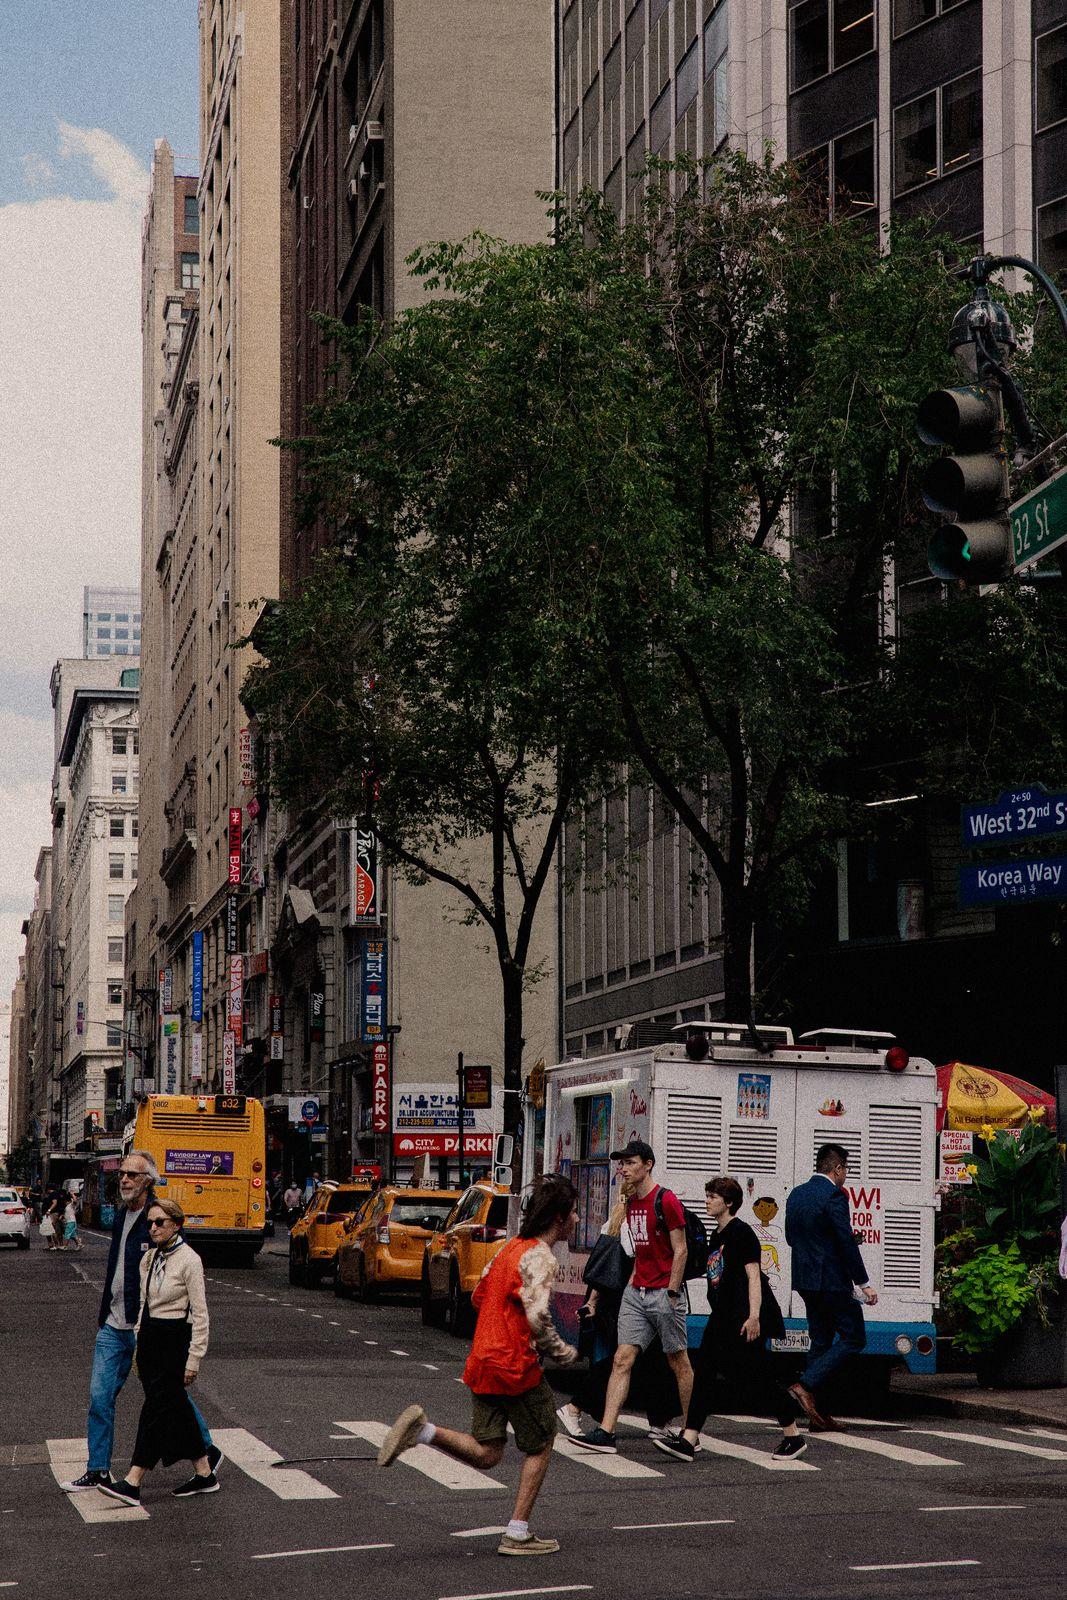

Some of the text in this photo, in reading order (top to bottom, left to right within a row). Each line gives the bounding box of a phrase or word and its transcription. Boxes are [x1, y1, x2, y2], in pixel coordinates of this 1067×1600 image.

[1014, 498, 1050, 556] 32 St
[970, 802, 1067, 837] West 32nd S
[230, 825, 240, 854] NAIL
[229, 856, 240, 882] BAR
[977, 863, 1062, 888] Korea Way
[357, 872, 366, 911] KARAOKE
[230, 959, 242, 992] SPA
[313, 992, 324, 1016] Plan
[374, 1062, 388, 1115] PARK
[399, 1094, 460, 1108] 서울한의
[954, 1116, 1022, 1125] All Beef Sausages
[843, 1187, 881, 1210] W!
[853, 1212, 872, 1227] FOR
